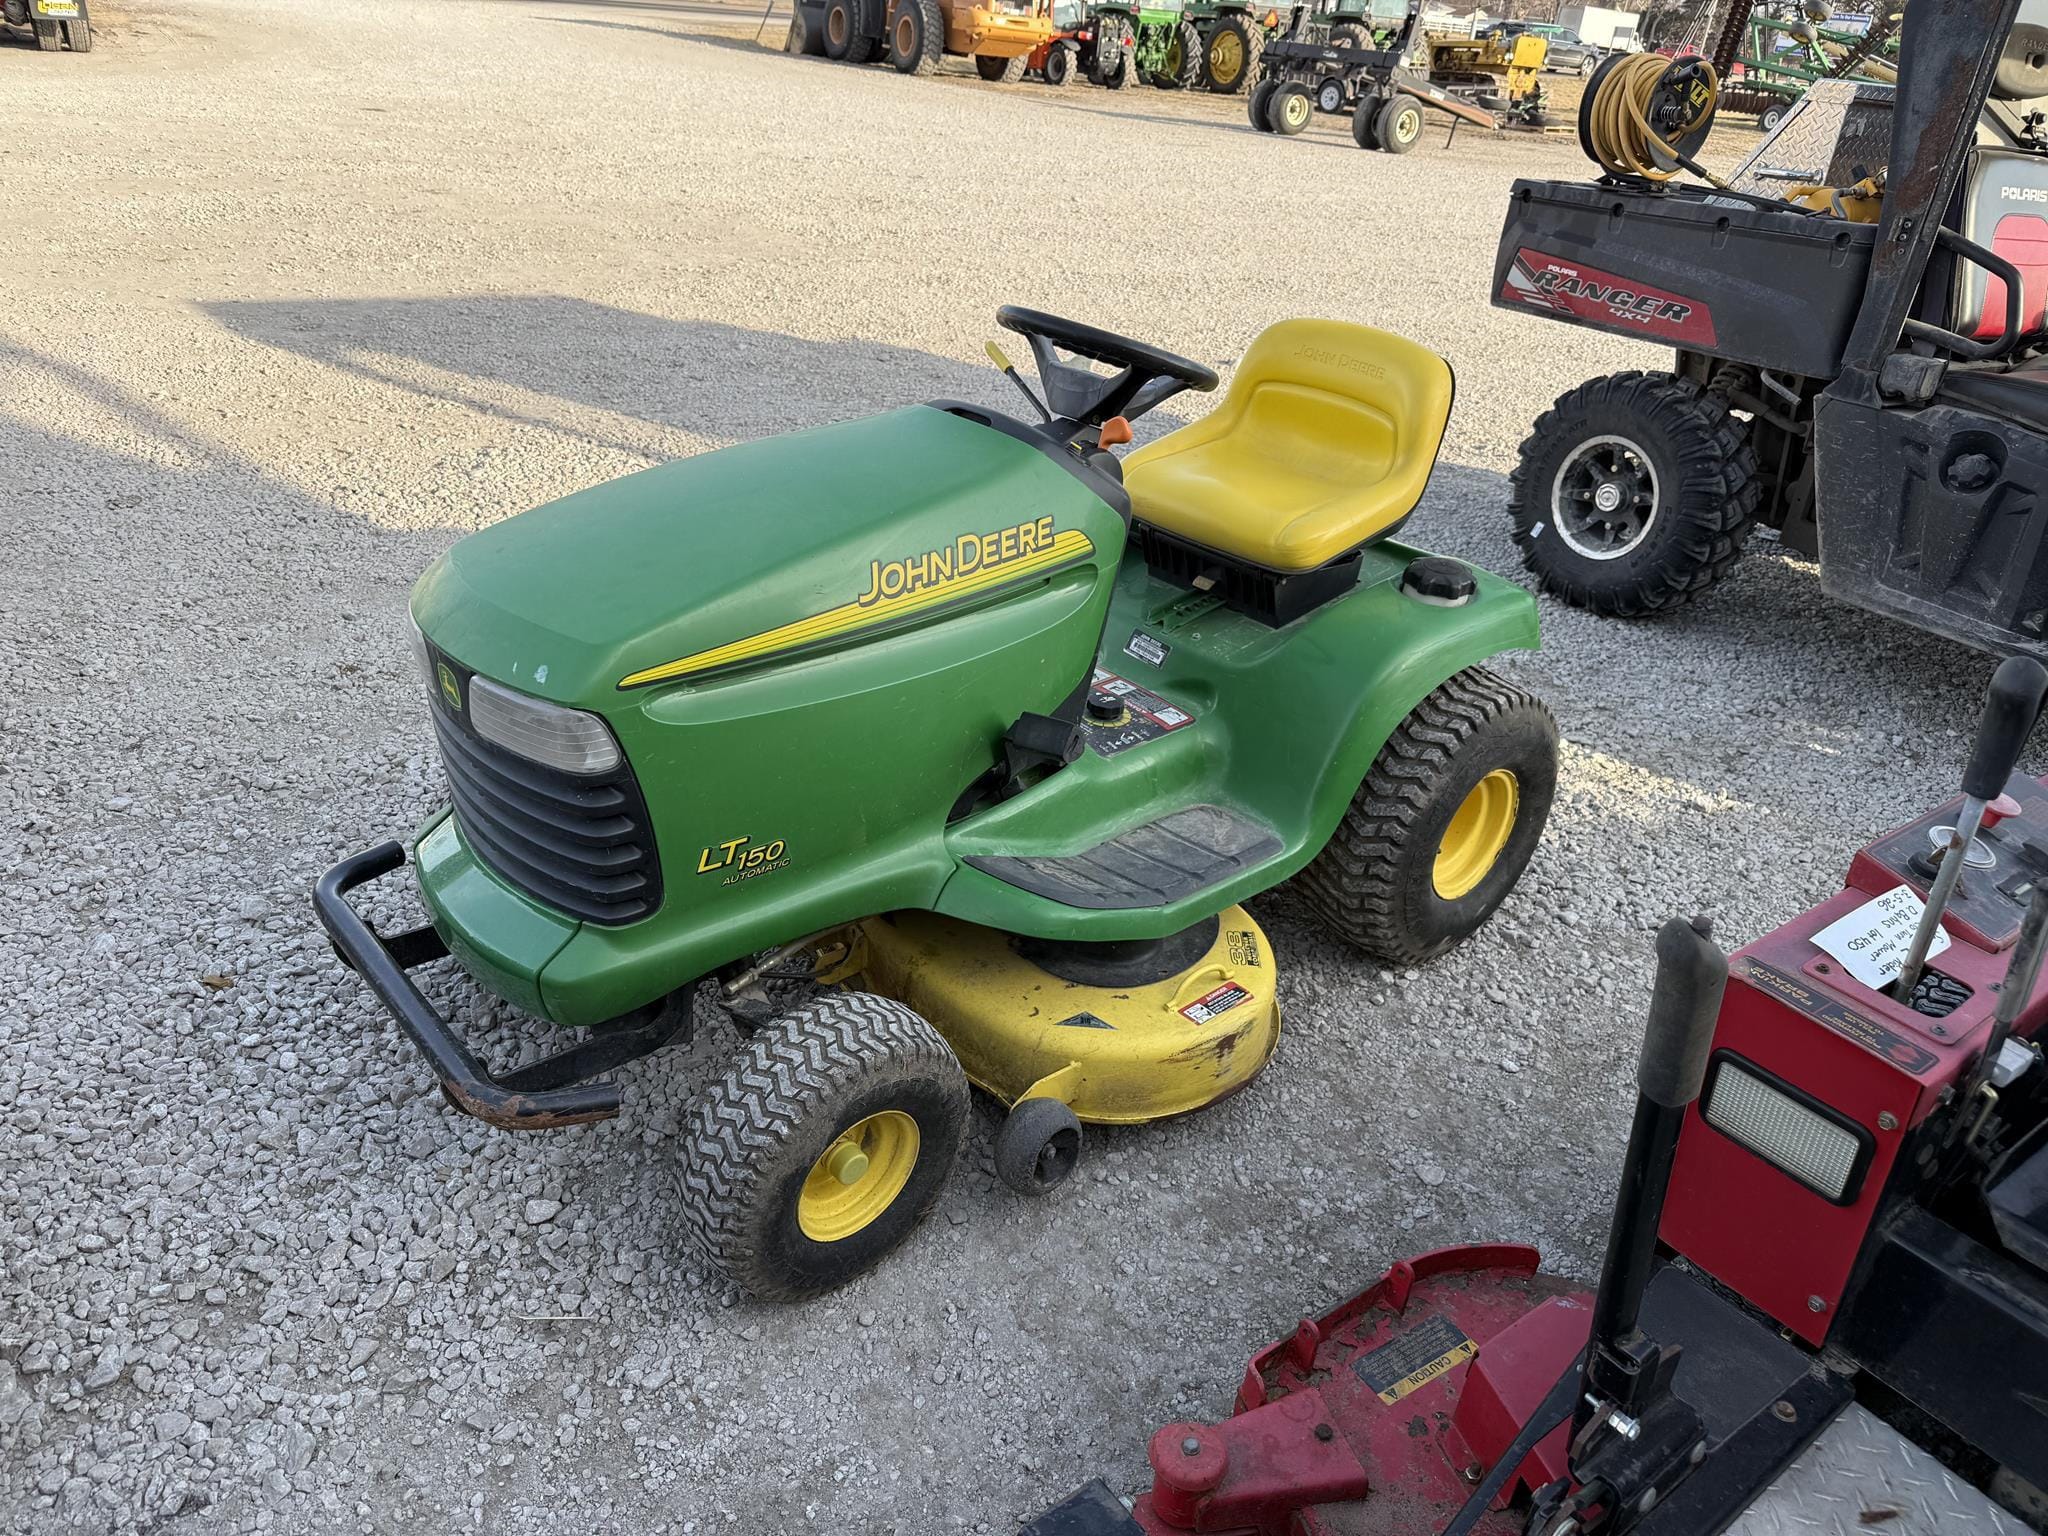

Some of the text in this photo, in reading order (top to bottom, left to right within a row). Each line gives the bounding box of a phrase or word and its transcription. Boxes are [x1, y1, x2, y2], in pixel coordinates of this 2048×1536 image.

[2021, 38, 2048, 50] RANGE
[2001, 186, 2048, 202] POLARIS
[1547, 264, 1578, 277] POLARIS
[1532, 270, 1692, 323] RANGER
[1293, 344, 1386, 380] JOHN DEERE
[858, 514, 1056, 608] JOHN DEERE
[697, 836, 785, 875] LT150
[721, 858, 791, 887] AUTOMATIC
[1226, 930, 1247, 966] 38
[1847, 935, 1872, 951] 450
[1870, 940, 1897, 962] Mower
[1751, 967, 1813, 1005] PARKIN
[1752, 966, 1809, 998] BRAKE
[1408, 1356, 1452, 1385] CAUTION
